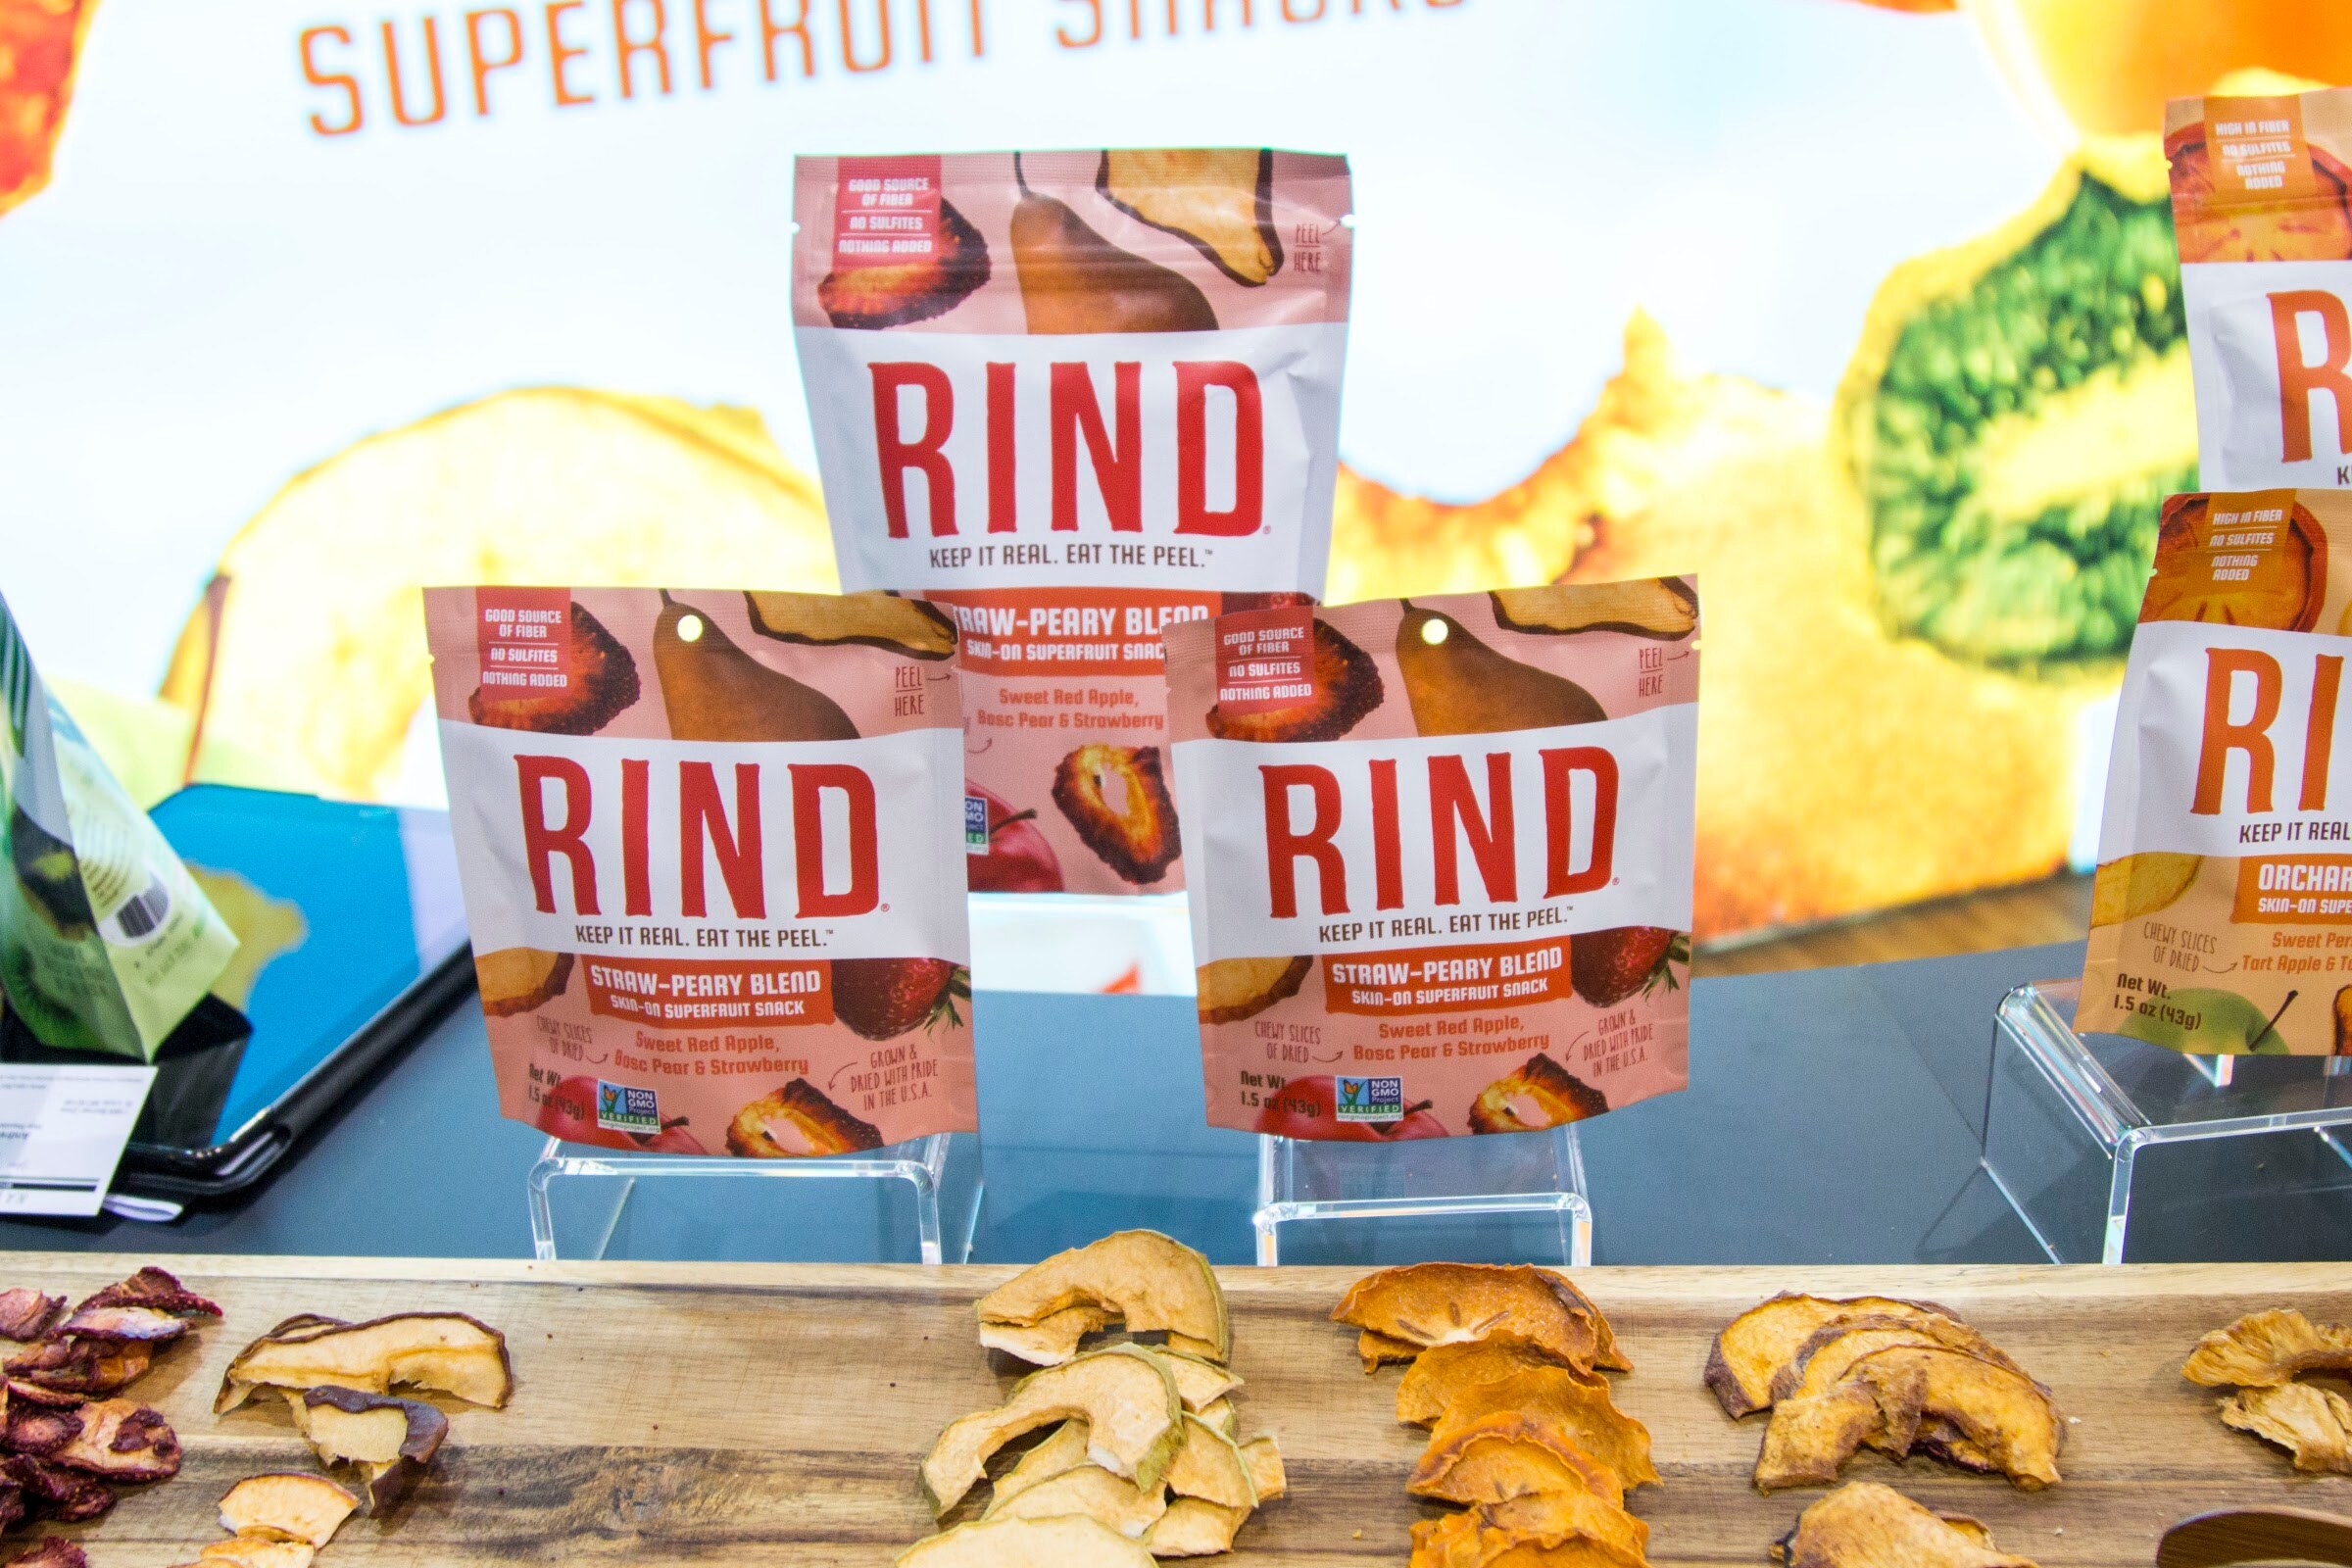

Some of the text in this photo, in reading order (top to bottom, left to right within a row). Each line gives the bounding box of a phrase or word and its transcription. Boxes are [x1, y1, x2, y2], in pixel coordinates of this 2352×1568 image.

[1294, 251, 1321, 271] HERE
[867, 361, 1264, 538] RIND
[2213, 509, 2284, 525] HIGH IN FIBER
[2210, 532, 2275, 547] NO SULFITES
[929, 548, 972, 568] KEEP
[979, 546, 996, 565] IT
[1003, 544, 1058, 565] REAL.
[1066, 544, 1102, 565] EAT
[1109, 544, 1147, 565] THE
[2211, 555, 2259, 567] NOTHING
[2212, 568, 2250, 581] ADDED
[485, 609, 563, 624] GOOD SOURCE
[499, 623, 548, 639] OF FIBER
[1223, 627, 1304, 646] GOOD SOURCE
[491, 648, 559, 663] NO SULFITES
[967, 639, 1165, 662] SKIN-ON SUPERFRUIT SNAC
[1239, 641, 1290, 656] OF FIBER
[1639, 647, 1663, 669] PEEL
[483, 671, 568, 688] NOTHING ADDED
[896, 665, 923, 688] PEEL
[1229, 662, 1301, 677] NO SULFITES
[1220, 683, 1312, 702] NOTHING ADDED
[1639, 674, 1664, 698] HERE
[894, 694, 925, 716] HERE
[999, 688, 1139, 708] Sweet Red Apple,
[977, 709, 1014, 727] Bosc
[1019, 712, 1054, 728] Pear
[1073, 712, 1164, 730] Strawberry
[514, 755, 880, 920] RIND
[1258, 746, 1619, 919] RIND
[2239, 823, 2282, 844] KEEP
[2287, 822, 2304, 841] IT
[2258, 898, 2317, 913] SKIN-ON
[575, 925, 613, 945] KEEP
[618, 927, 634, 946] IT
[640, 928, 690, 948] REAL.
[697, 929, 731, 948] EAT
[736, 929, 770, 948] THE
[1319, 923, 1362, 943] KEEP
[1369, 921, 1386, 939] IT
[1392, 917, 1443, 937] REAL.
[1449, 914, 1483, 933] EAT
[1489, 911, 1521, 931] THE
[2144, 921, 2217, 955] CHEWY SLICES
[2272, 932, 2322, 949] Sweet
[1332, 947, 1563, 987] STRAW-PEARY BLEND
[2153, 946, 2200, 973] OF DRIED
[2242, 955, 2274, 971] Tart
[2278, 955, 2322, 974] Apple
[590, 964, 822, 997] STRAW-PEARY BLEND
[1351, 977, 1548, 1006] SKIN-ON SUPERFRUIT SNACK
[2117, 972, 2171, 1000] Net Wt.
[611, 995, 805, 1019] SKIN-ON SUPERFRUIT SNACK
[2114, 994, 2201, 1031] 1.5 oz (43g)
[1254, 1021, 1321, 1046] CHEWY SLICES
[1379, 1015, 1525, 1039] Sweet Red Apple,
[1598, 1011, 1627, 1036] GROWN
[636, 1030, 780, 1054] Sweet Red Apple,
[1266, 1042, 1309, 1064] OF DRIED
[1353, 1045, 1395, 1061] Bosc
[1400, 1044, 1438, 1059] Pear
[1457, 1034, 1549, 1056] Strawberry
[1584, 1023, 1653, 1061] DRIED WITH PRIDE
[614, 1049, 648, 1072] Bosc
[653, 1057, 690, 1075] Pear
[710, 1056, 809, 1076] Strawberry
[870, 1046, 906, 1069] GROWN
[1593, 1046, 1648, 1078] IN THE U.S.A.
[851, 1059, 939, 1094] DRIED WITH PRIDE
[1241, 1070, 1263, 1088] Net
[1372, 1080, 1398, 1089] NON
[627, 1090, 654, 1101] NON
[627, 1098, 655, 1109] GMO
[863, 1081, 932, 1111] IN THE U.S.A.
[1241, 1091, 1259, 1106] 1.5
[1371, 1088, 1399, 1097] GMO
[601, 1111, 657, 1125] VERIFIED
[1341, 1104, 1400, 1113] VERIFIED
